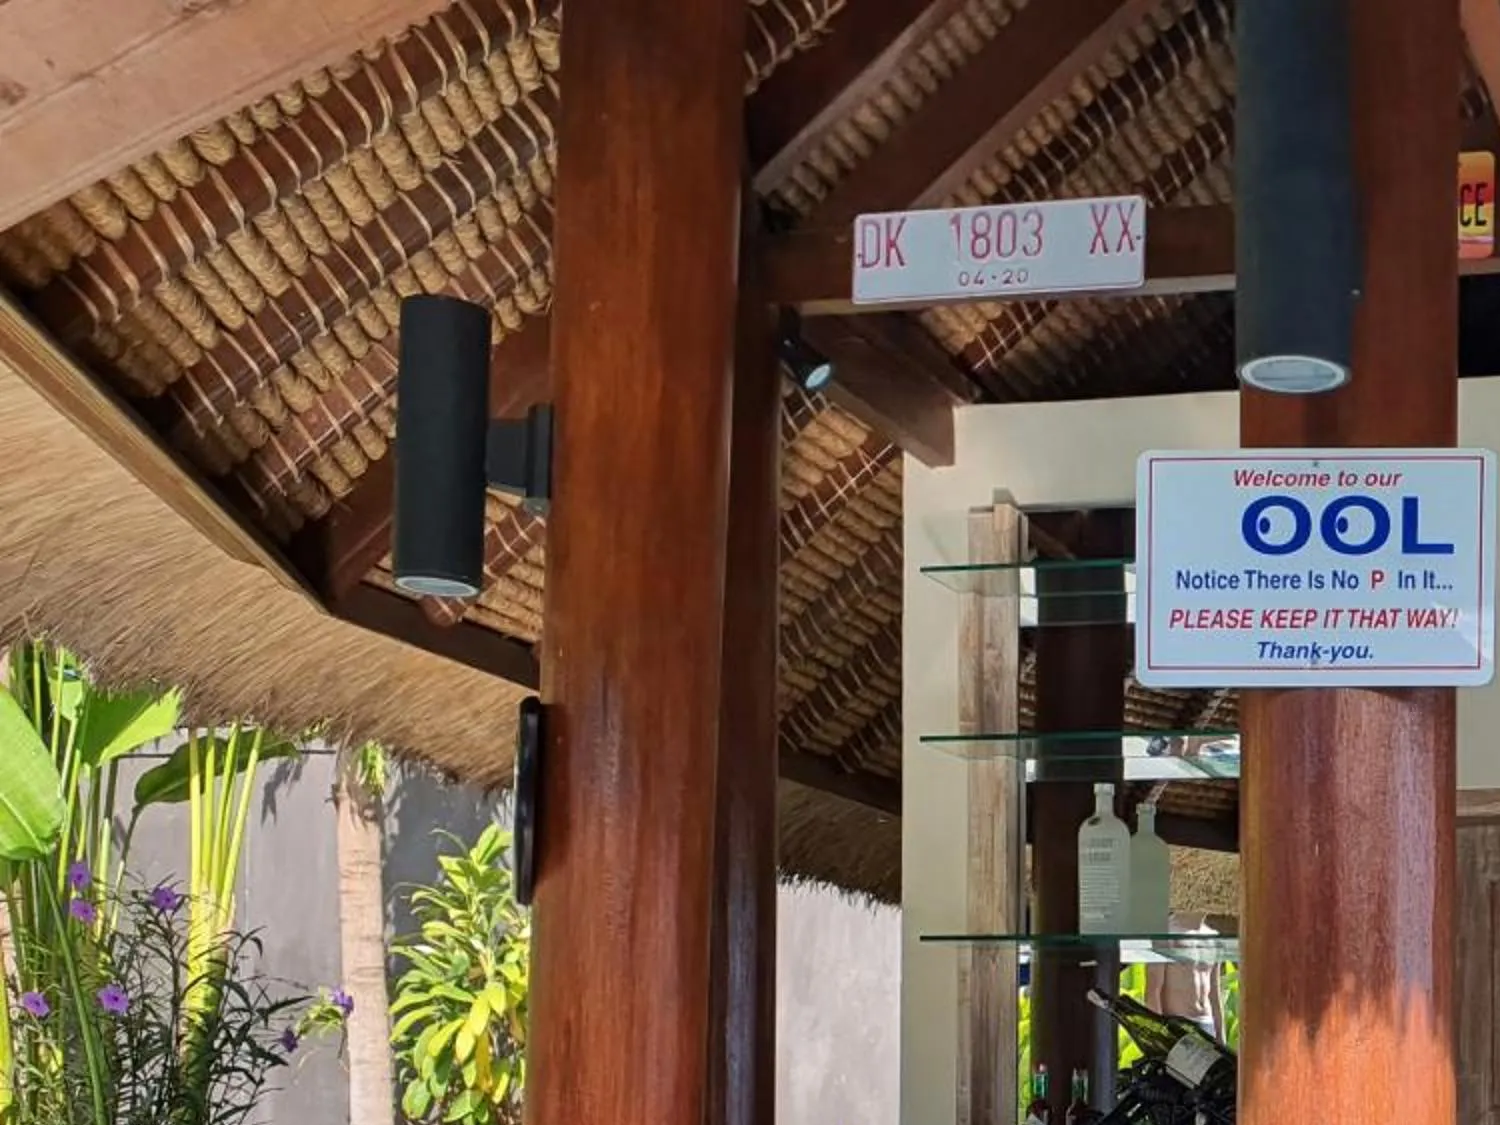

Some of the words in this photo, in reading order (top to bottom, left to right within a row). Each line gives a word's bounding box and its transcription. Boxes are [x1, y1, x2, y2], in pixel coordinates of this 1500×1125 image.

[860, 216, 906, 268] DK
[950, 208, 1044, 260] 1803
[1088, 203, 1136, 255] XX
[1233, 469, 1330, 487] Welcome
[1337, 470, 1358, 487] to
[1364, 473, 1402, 487] our
[1241, 495, 1455, 556] OOL
[1175, 570, 1240, 590] Notice
[1244, 570, 1301, 590] There
[1308, 570, 1325, 590] Is
[1331, 570, 1359, 590] No
[1370, 570, 1384, 590] P
[1397, 570, 1416, 590] In
[1422, 570, 1454, 590] It...
[1169, 609, 1254, 629] PLEASE
[1260, 609, 1318, 629] KEEP
[1323, 609, 1345, 629] IT
[1347, 608, 1402, 629] THAT
[1406, 608, 1460, 629] WAY!
[1256, 641, 1375, 664] Thank-you.
